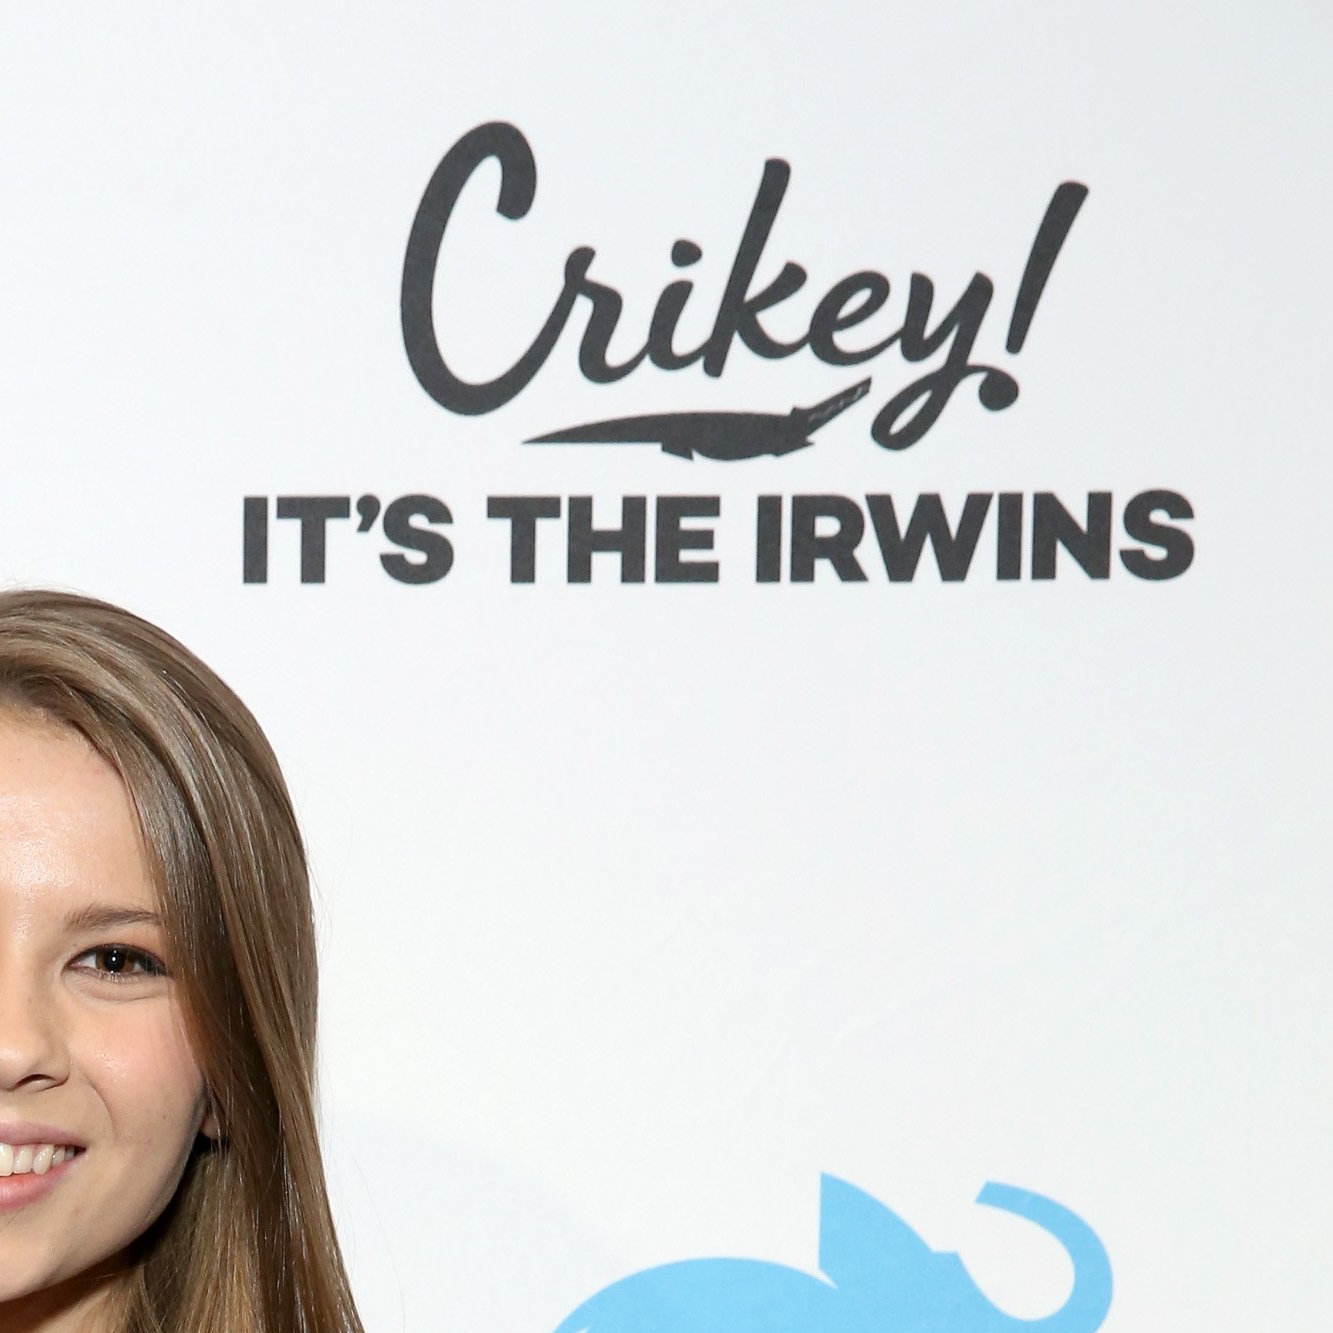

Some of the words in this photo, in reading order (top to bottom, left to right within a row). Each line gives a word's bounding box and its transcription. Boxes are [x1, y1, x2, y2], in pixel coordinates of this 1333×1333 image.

[401, 122, 1089, 451] Crikey!
[243, 495, 454, 585] IT'S
[487, 496, 720, 584] THE
[756, 489, 1195, 583] IRWINS
